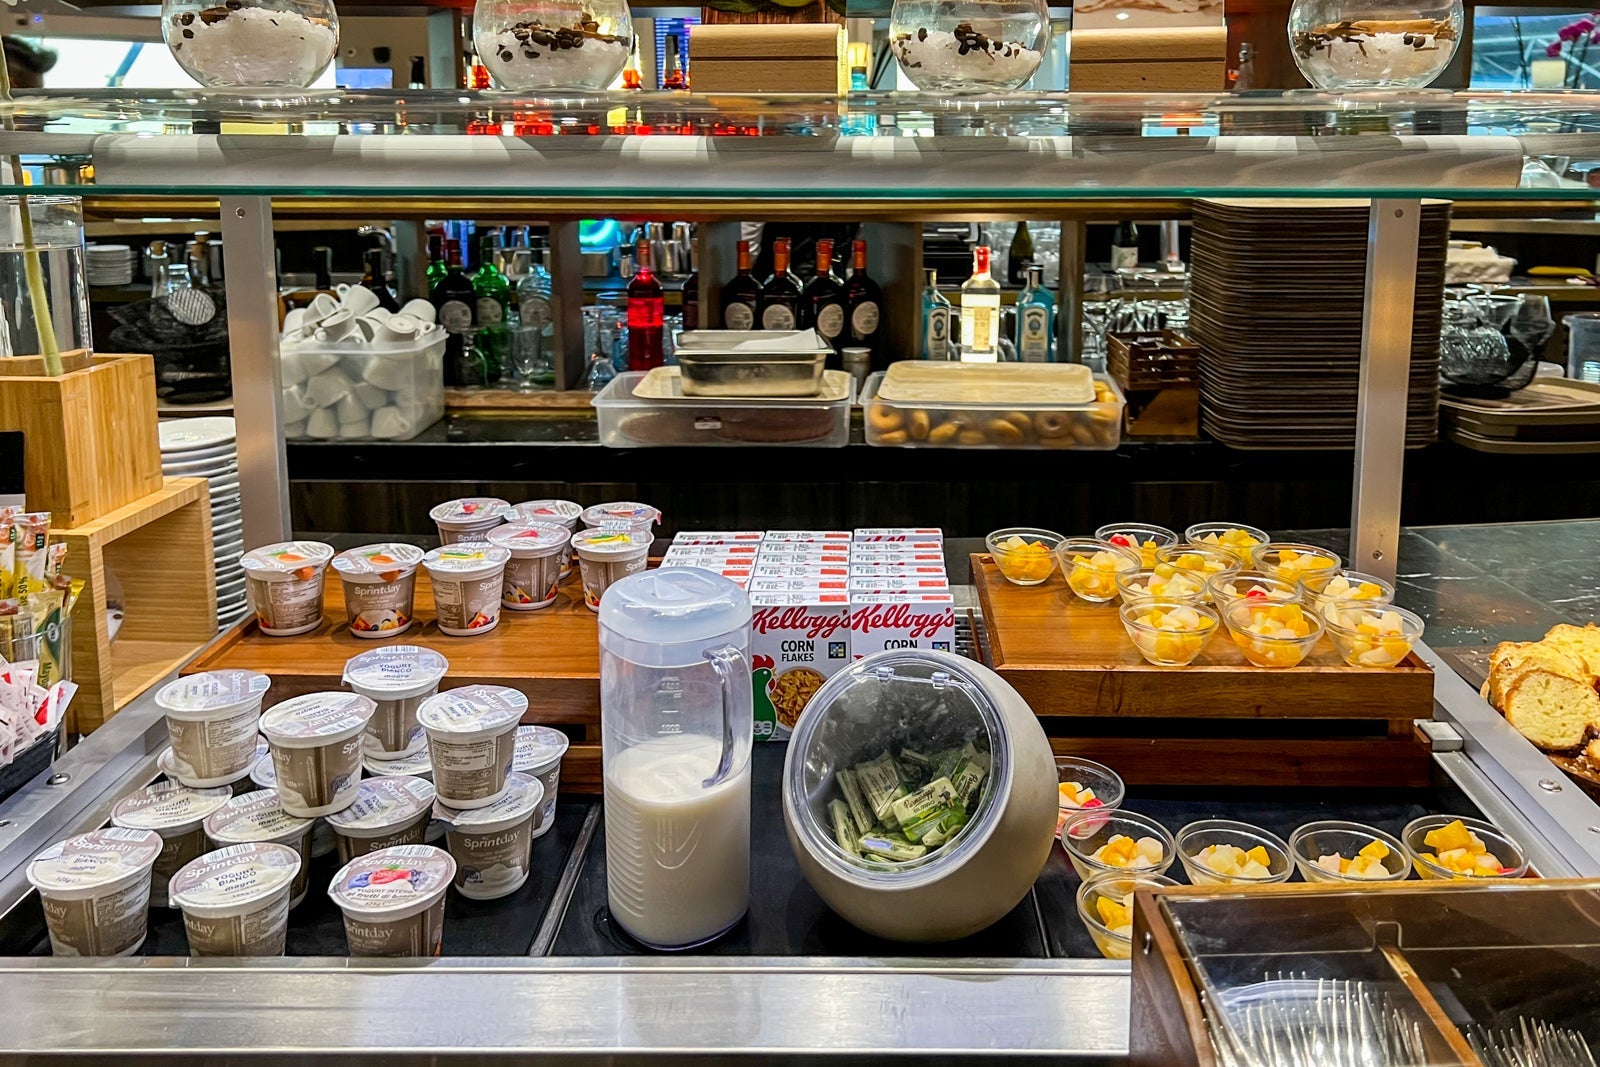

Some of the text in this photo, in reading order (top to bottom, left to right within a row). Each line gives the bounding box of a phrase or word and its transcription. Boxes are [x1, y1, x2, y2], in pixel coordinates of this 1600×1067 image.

[354, 583, 402, 597] Sprintday
[752, 605, 851, 639] Kellogg's
[851, 603, 954, 638] Kellogg's
[781, 640, 815, 653] CORN
[884, 639, 918, 651] CORN
[781, 652, 815, 662] FLAKES
[215, 798, 280, 821] Sprintday
[464, 830, 520, 850] Sprintday
[185, 853, 259, 878] Sprintday
[214, 867, 255, 882] YOGURT
[218, 871, 257, 887] BIANCO
[224, 879, 256, 892] magro
